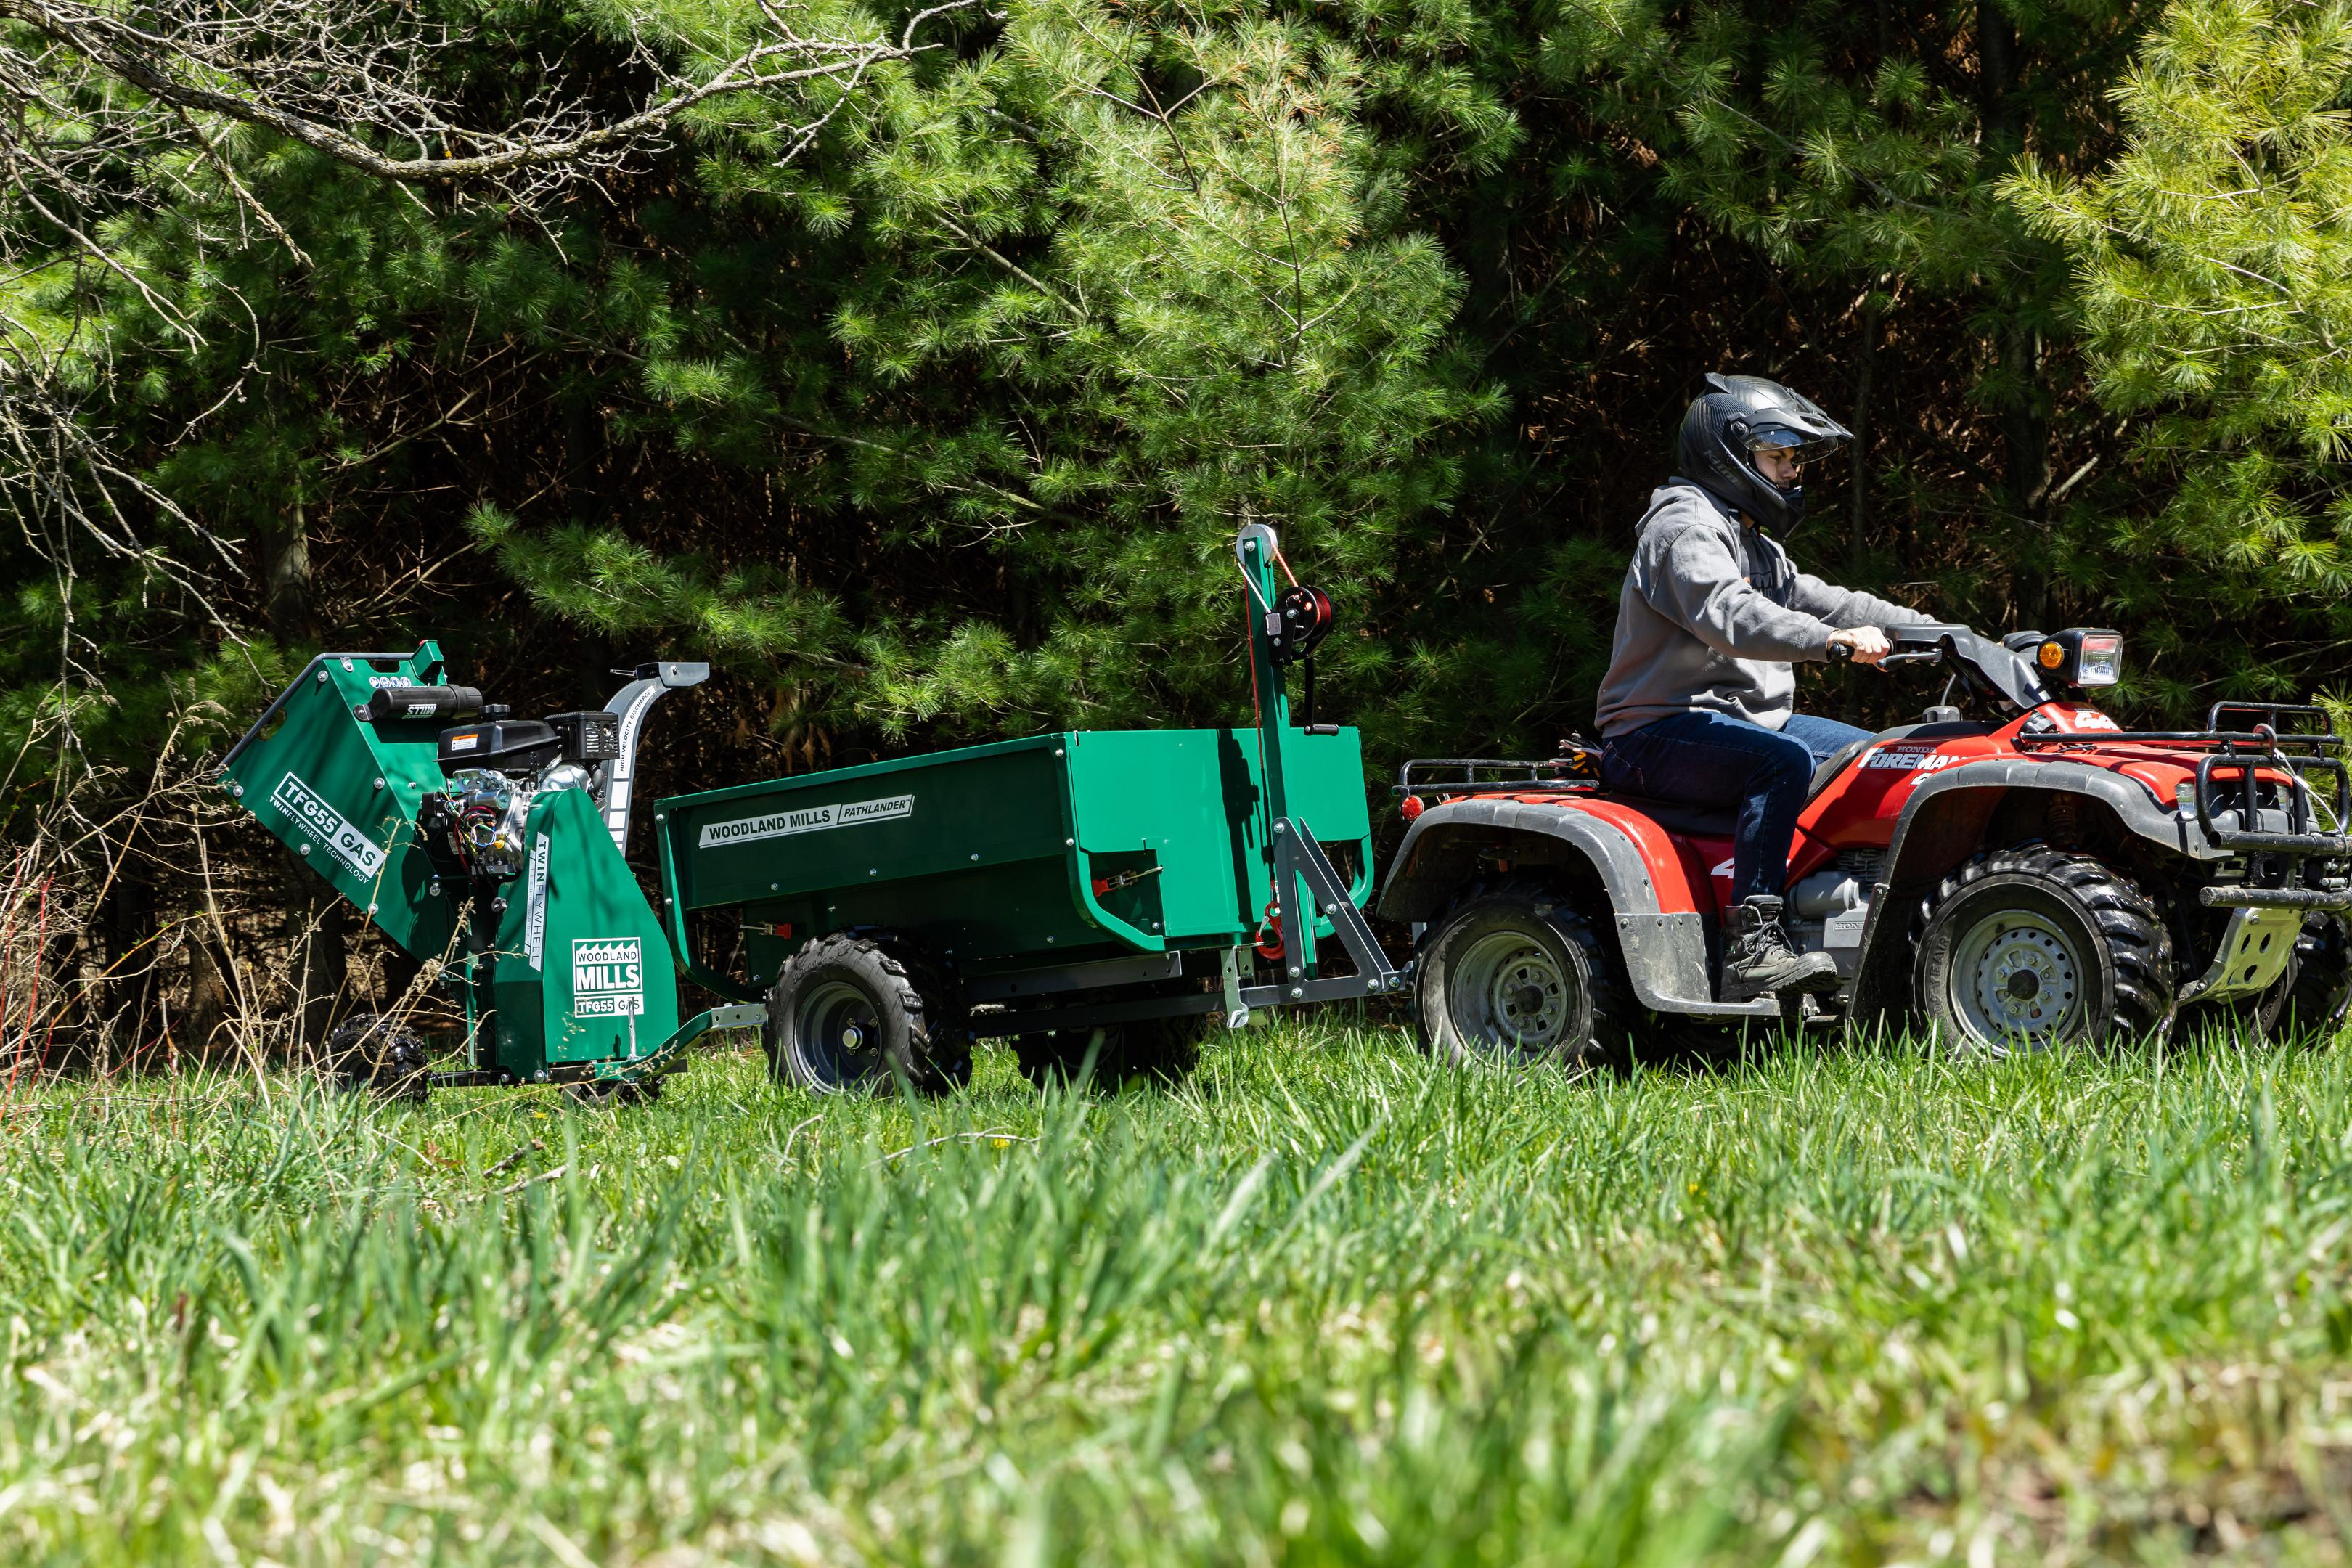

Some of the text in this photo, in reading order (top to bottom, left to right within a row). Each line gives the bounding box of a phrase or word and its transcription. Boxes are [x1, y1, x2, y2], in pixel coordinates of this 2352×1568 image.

[407, 706, 436, 715] MILLS
[621, 720, 632, 752] VELOCITY
[630, 690, 650, 720] DISCHARGE
[285, 781, 376, 867] TFG55 GAS
[709, 817, 785, 840] WOODLAND
[790, 809, 830, 828] MILLS
[269, 796, 369, 885] TWINFLYWHEEL TECHNOLOGY
[531, 841, 546, 963] TWINFLYWHEEL
[578, 951, 637, 962] WOODLAND
[576, 964, 640, 991] MILLS
[578, 999, 640, 1013] TFG55 GS
